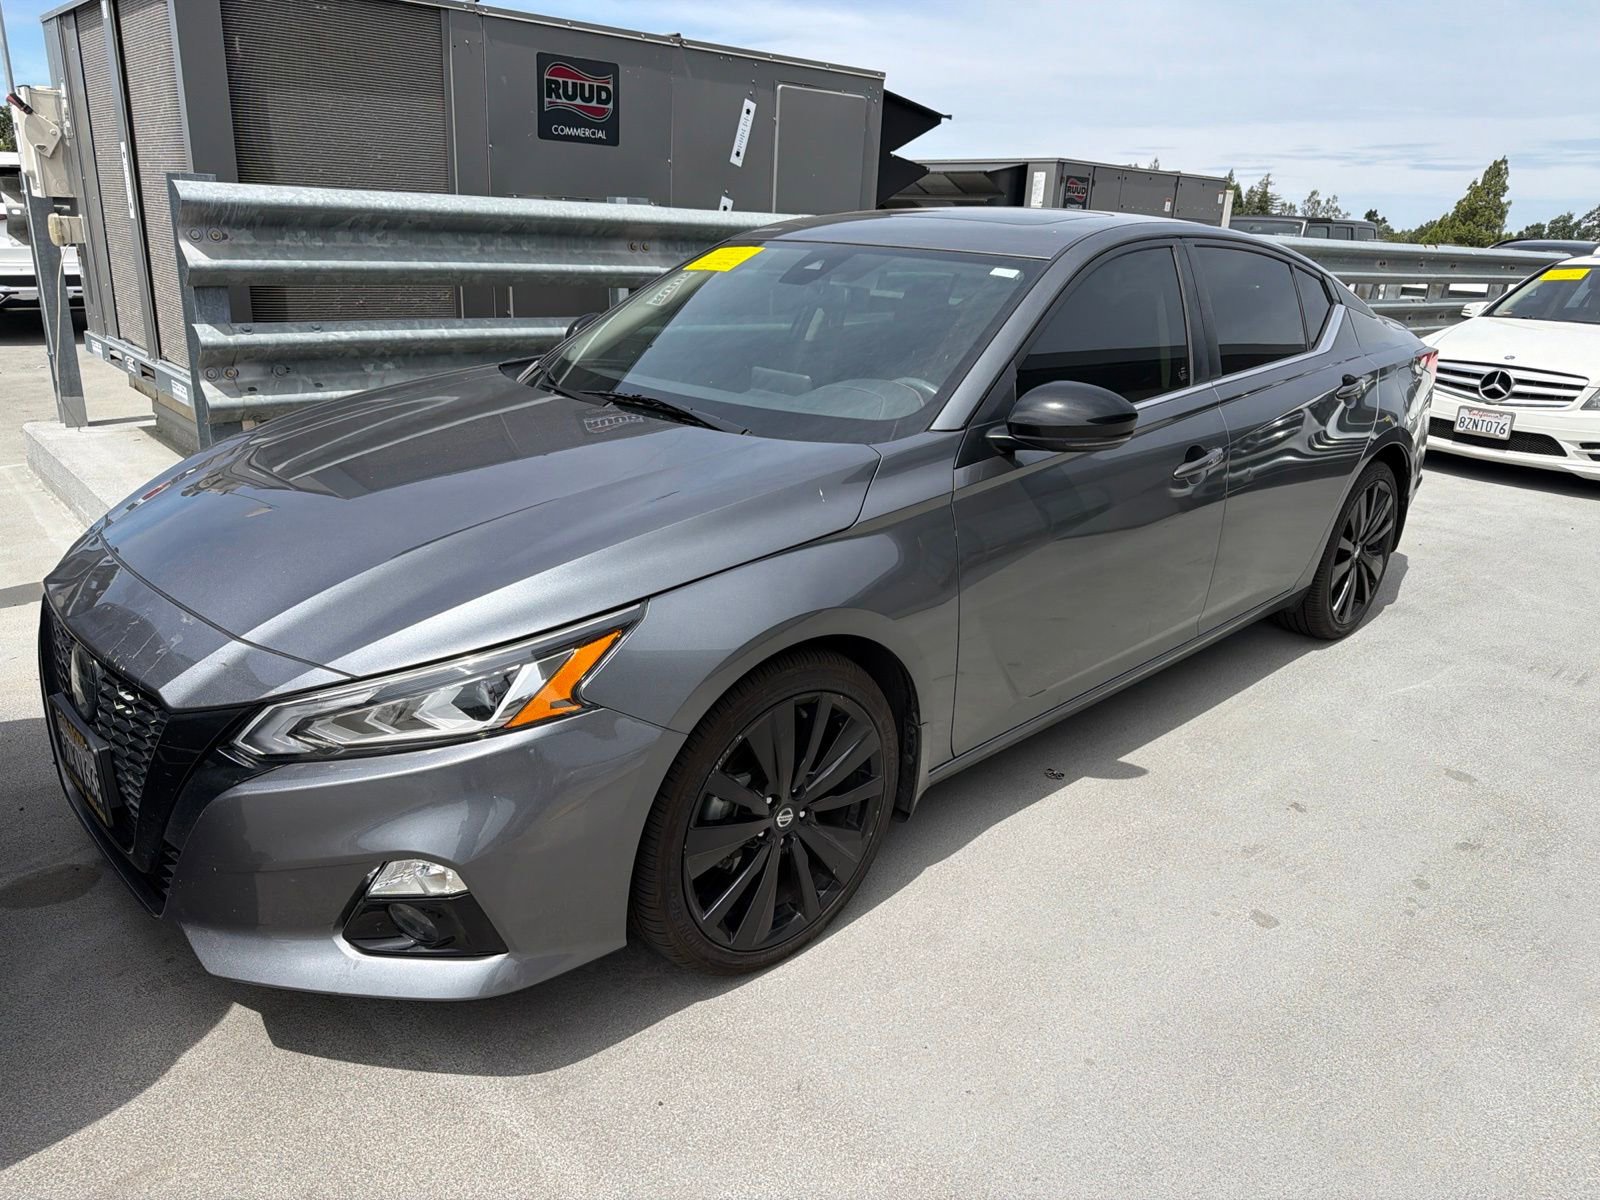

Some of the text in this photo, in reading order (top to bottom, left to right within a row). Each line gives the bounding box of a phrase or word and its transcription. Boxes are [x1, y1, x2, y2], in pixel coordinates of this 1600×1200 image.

[545, 78, 612, 106] RUUD
[551, 124, 607, 140] COMMERCIAL
[1066, 185, 1087, 195] RUUD
[1458, 416, 1508, 435] 8ZNT076
